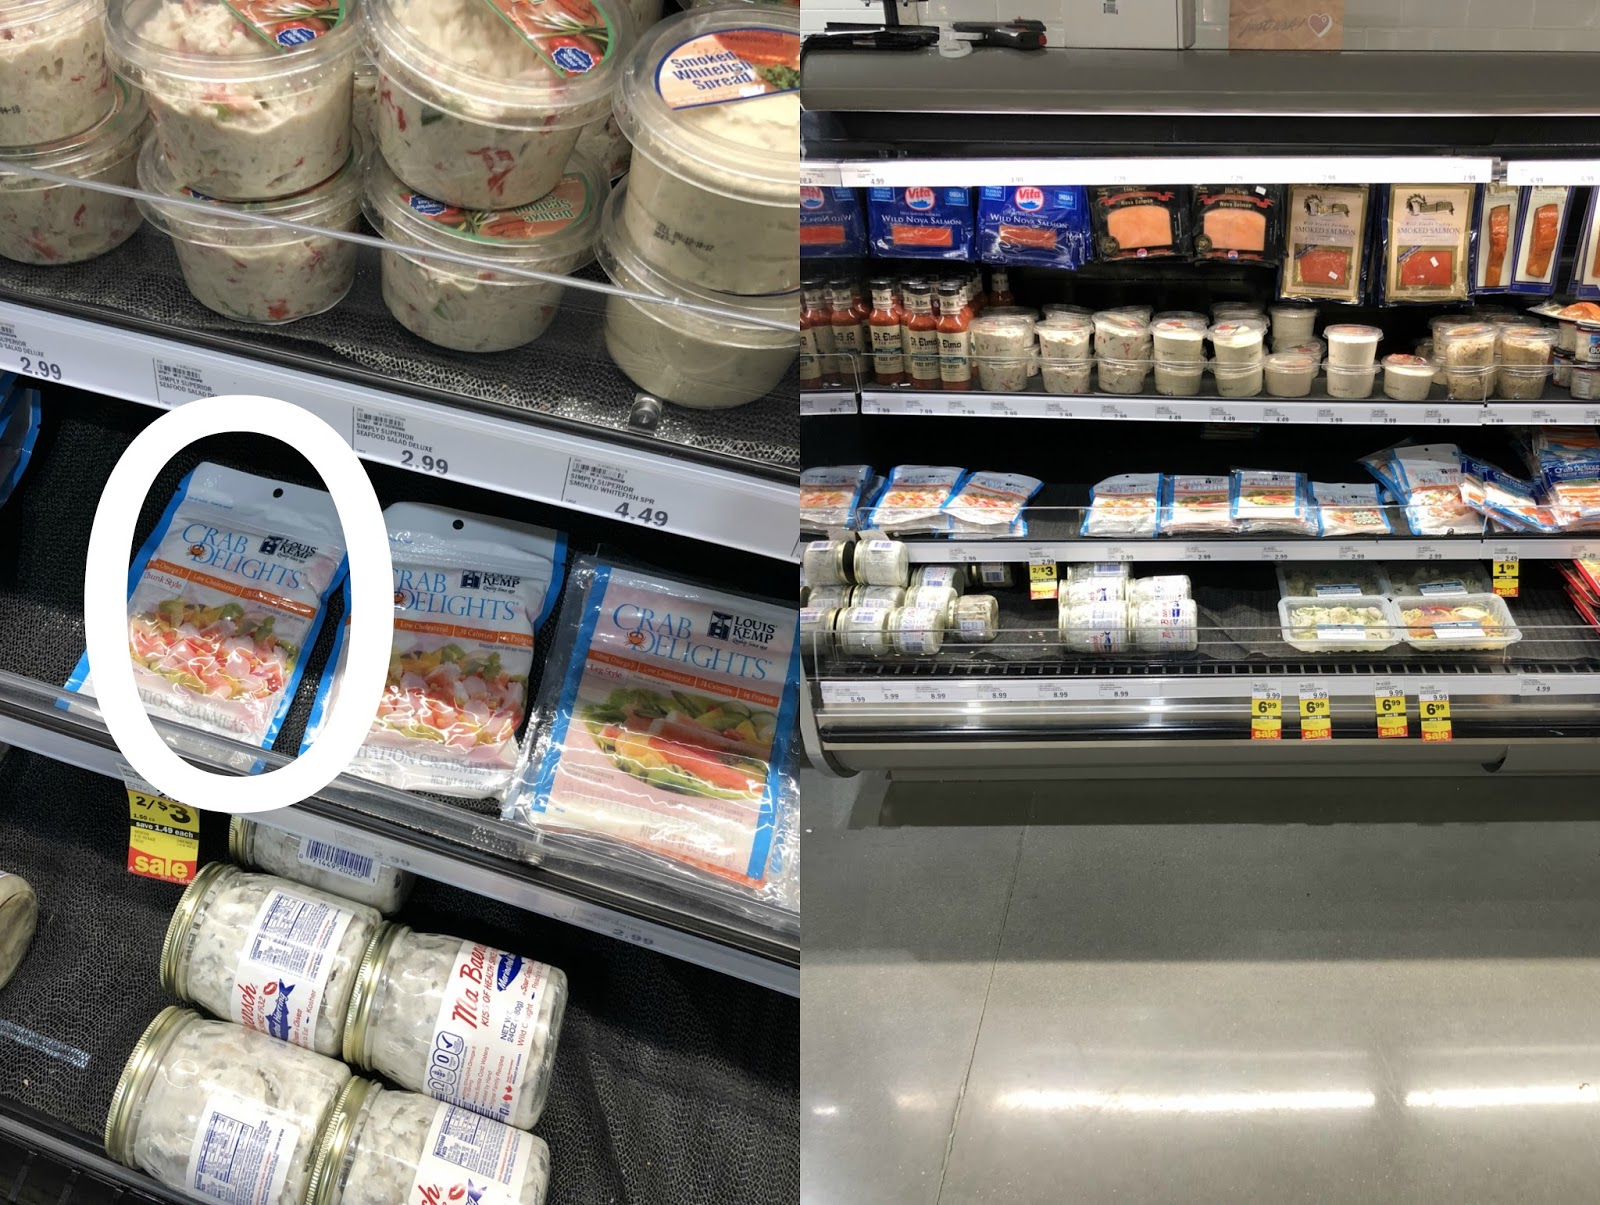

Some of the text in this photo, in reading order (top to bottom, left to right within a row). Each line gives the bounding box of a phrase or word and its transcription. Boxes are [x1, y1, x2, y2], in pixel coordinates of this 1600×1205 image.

[670, 51, 738, 69] Smoked
[672, 60, 753, 81] Whitefish
[692, 72, 753, 91] Spread
[908, 187, 931, 198] Vita
[1018, 188, 1040, 200] Vita
[906, 215, 929, 224] NOVA
[930, 216, 962, 226] SALMON
[1294, 225, 1356, 236] SMOKED SALMON
[1396, 227, 1461, 235] SMOKED SALMON
[942, 341, 962, 349] Elmo
[20, 356, 62, 381] 2.99
[158, 373, 212, 393] SIMPLY SUPERIOR
[158, 380, 207, 398] SEAFOOD SALAD
[356, 422, 415, 442] SIMPLY SUPERIOR
[356, 428, 433, 453] SEAFOOD SALAD DELUXE
[400, 449, 449, 475] 2.99
[570, 472, 634, 493] SIMPLY SUPERIOR
[569, 479, 655, 506] SMOKED WHITEFISH SPR
[614, 501, 669, 527] 4.49
[182, 523, 249, 554] CRAB
[283, 539, 316, 555] LOUIS
[279, 544, 313, 559] KEMP
[192, 543, 304, 590] DELIGHTS
[164, 577, 183, 589] Style
[193, 573, 204, 582] Low
[482, 577, 521, 589] KEMP
[1495, 588, 1516, 596] sale
[396, 588, 516, 621] DELIGHTS
[400, 621, 449, 634] Low Cholesterol
[613, 603, 693, 640] CRAB
[734, 616, 776, 634] LOUIS
[467, 629, 493, 640] Calories
[732, 625, 774, 644] KEMP
[631, 628, 768, 681] DELIGHTS
[604, 667, 623, 679] Style
[707, 682, 775, 705] Calories Protein
[930, 692, 946, 700] 8.99
[1266, 692, 1281, 700] 9.99
[1389, 689, 1404, 697] 9.99
[1535, 685, 1551, 693] 4.99
[1254, 730, 1278, 739] sale
[1305, 729, 1329, 739] sale
[1381, 727, 1405, 737] sale
[1424, 731, 1449, 741] sale
[135, 796, 191, 824] 2/$3
[135, 821, 194, 839] save 1.49 each
[134, 855, 189, 879] sale
[338, 865, 363, 879] 20220
[483, 963, 495, 992] HEALTH
[520, 977, 531, 993] Sour
[258, 995, 267, 1011] 1932
[274, 991, 289, 1019] Herring
[305, 989, 318, 1014] Kosher
[482, 990, 491, 1004] OF
[451, 987, 480, 1030] Ma
[512, 1000, 525, 1022] (80g)
[500, 1025, 511, 1041] NET
[516, 1002, 534, 1047] Wild Cught
[497, 1055, 505, 1075] Recipes
